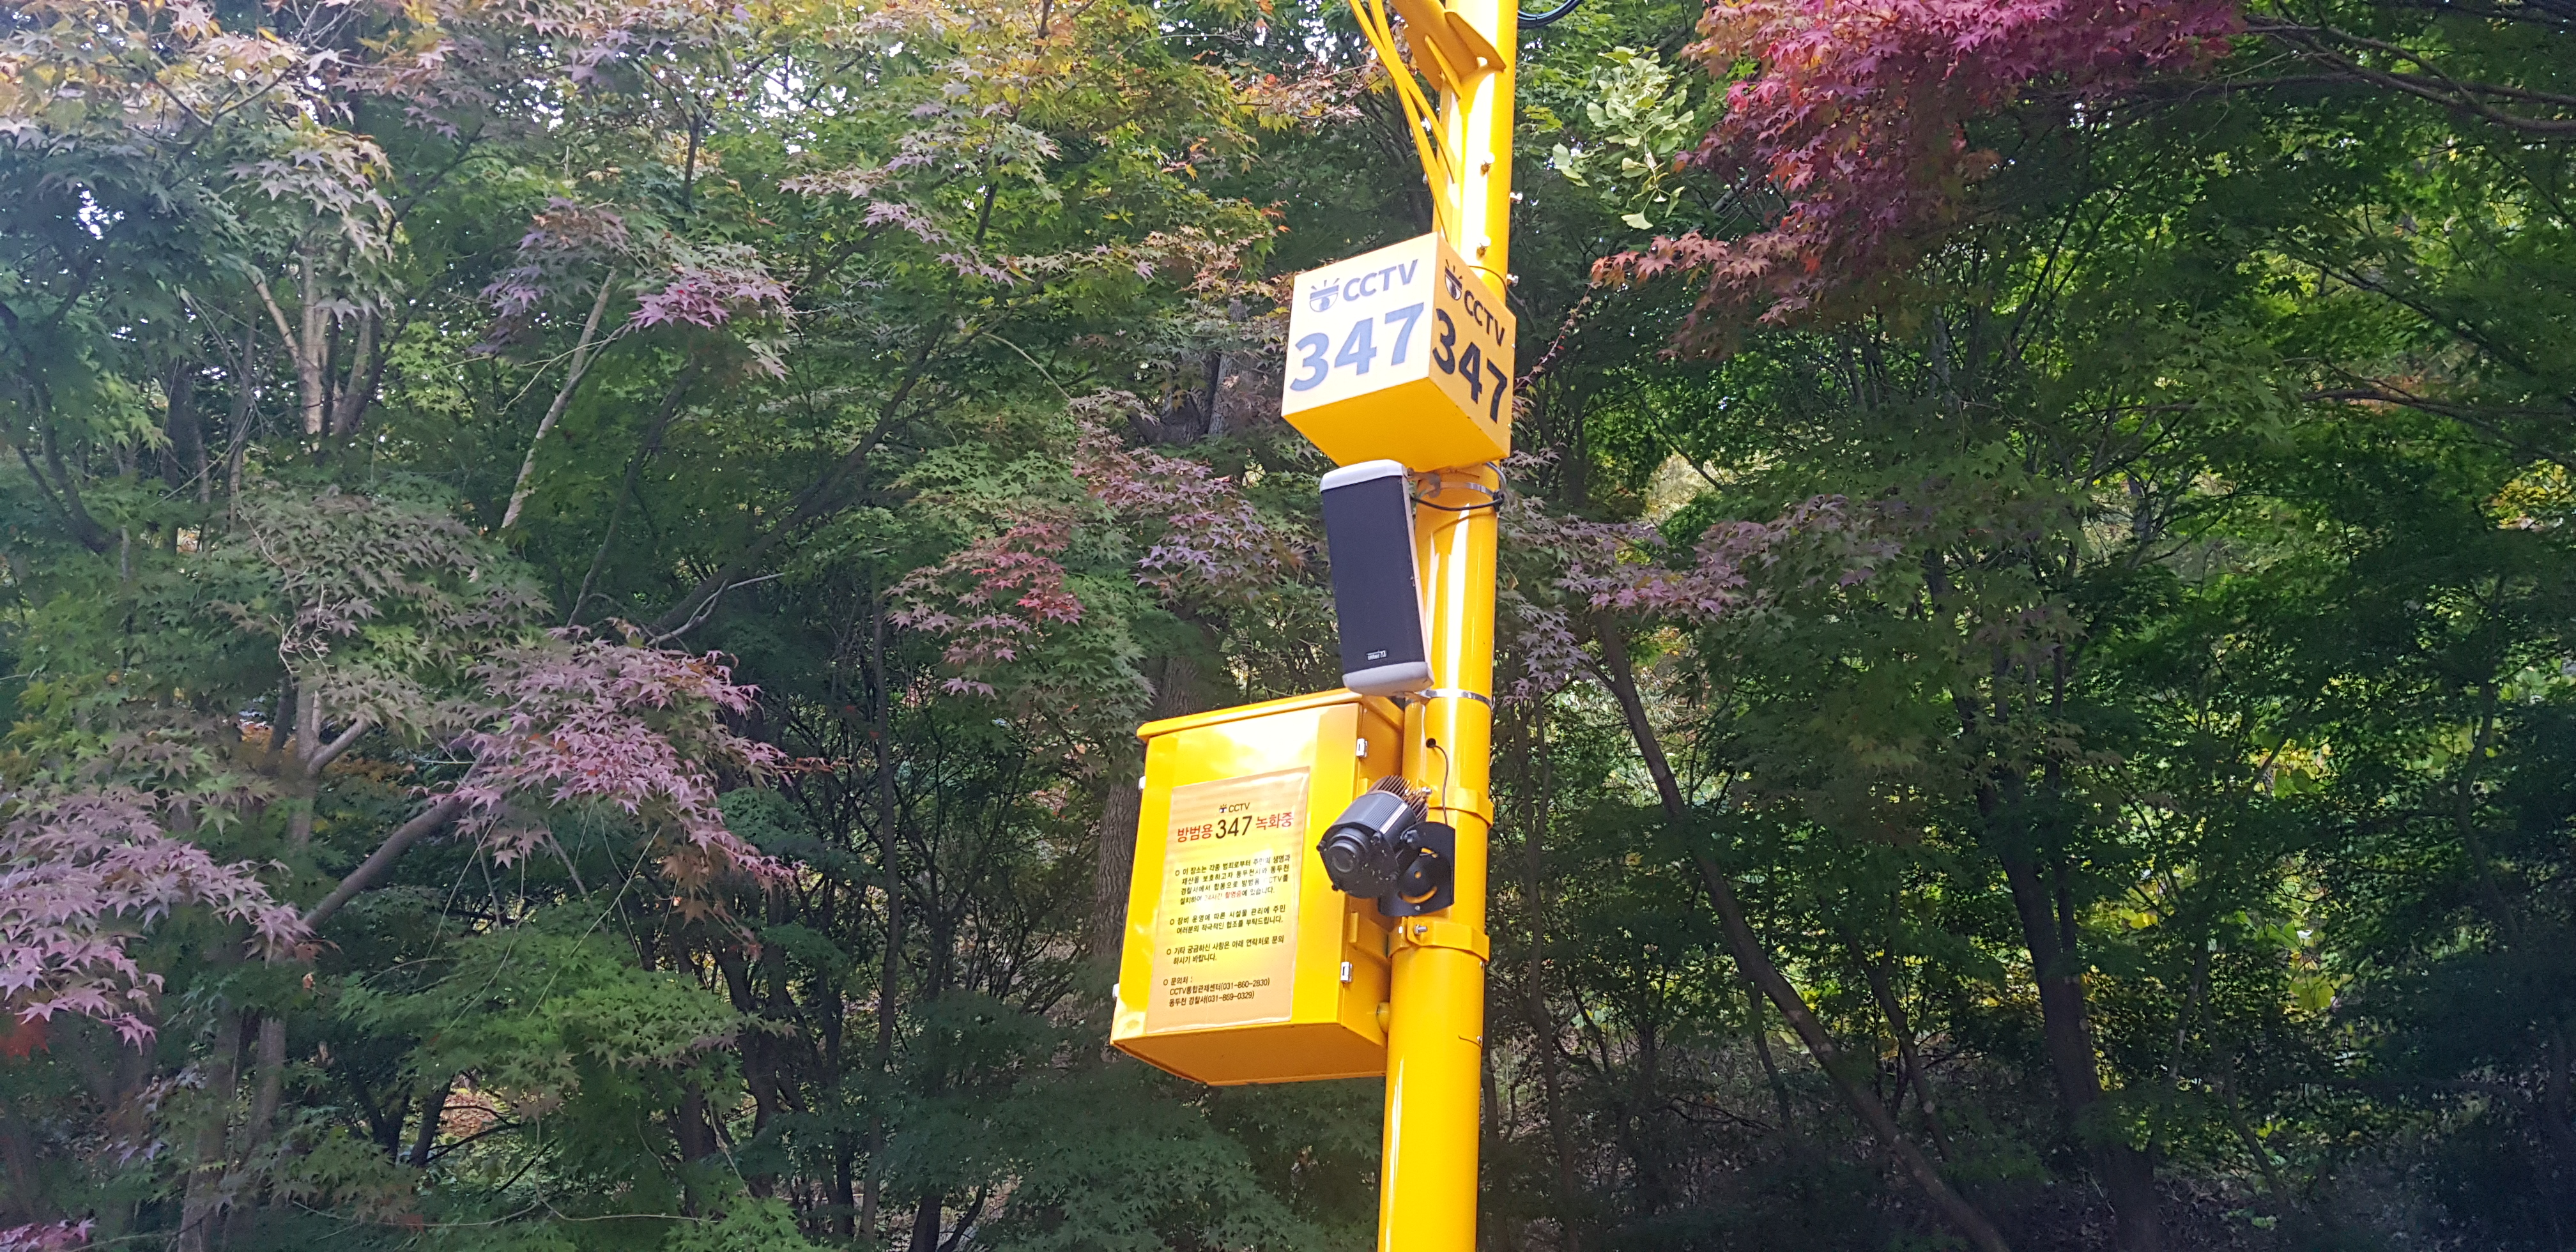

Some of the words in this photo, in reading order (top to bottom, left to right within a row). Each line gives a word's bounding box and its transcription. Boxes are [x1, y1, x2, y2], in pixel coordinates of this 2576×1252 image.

[1343, 259, 1418, 302] CCTV
[1464, 290, 1505, 347] CCTV
[1289, 302, 1424, 392] 347
[1432, 308, 1508, 424] 347
[1228, 802, 1250, 813] CCTV
[1177, 823, 1213, 843] 방범용
[1215, 815, 1253, 839] 347
[1255, 811, 1294, 830] 녹화중
[1190, 866, 1207, 874] 장소는
[1223, 859, 1251, 870] 범죄로부터
[1273, 854, 1290, 864] 생명과
[1182, 876, 1199, 885] 재산을
[1202, 871, 1233, 882] 보호하고자
[1236, 867, 1267, 878] 동두천시와
[1270, 864, 1289, 874] 동두천
[1181, 885, 1211, 896] 경찰서에서
[1214, 881, 1238, 890] 합동으로
[1241, 878, 1260, 887] 방범용
[1180, 895, 1202, 905] 설치하여
[1177, 916, 1189, 925] 장비
[1192, 913, 1211, 923] 운영에
[1213, 912, 1225, 920] 따른
[1229, 909, 1247, 918] 시설물
[1251, 906, 1269, 916] 관리에
[1273, 904, 1285, 913] 주민
[1176, 925, 1199, 935] 여러분의
[1201, 922, 1224, 931] 적극적인
[1227, 919, 1243, 929] 협조를
[1174, 946, 1185, 955] 기타
[1187, 943, 1210, 954] 궁금하신
[1212, 941, 1230, 950] 사항은
[1232, 939, 1244, 949] 아래
[1246, 936, 1269, 947] 연락처로
[1272, 935, 1284, 944] 문의
[1173, 956, 1191, 965] 하시기
[1192, 952, 1217, 963] 바랍니다.
[1170, 976, 1188, 986] 문의처
[1169, 997, 1186, 1007] 동두천
